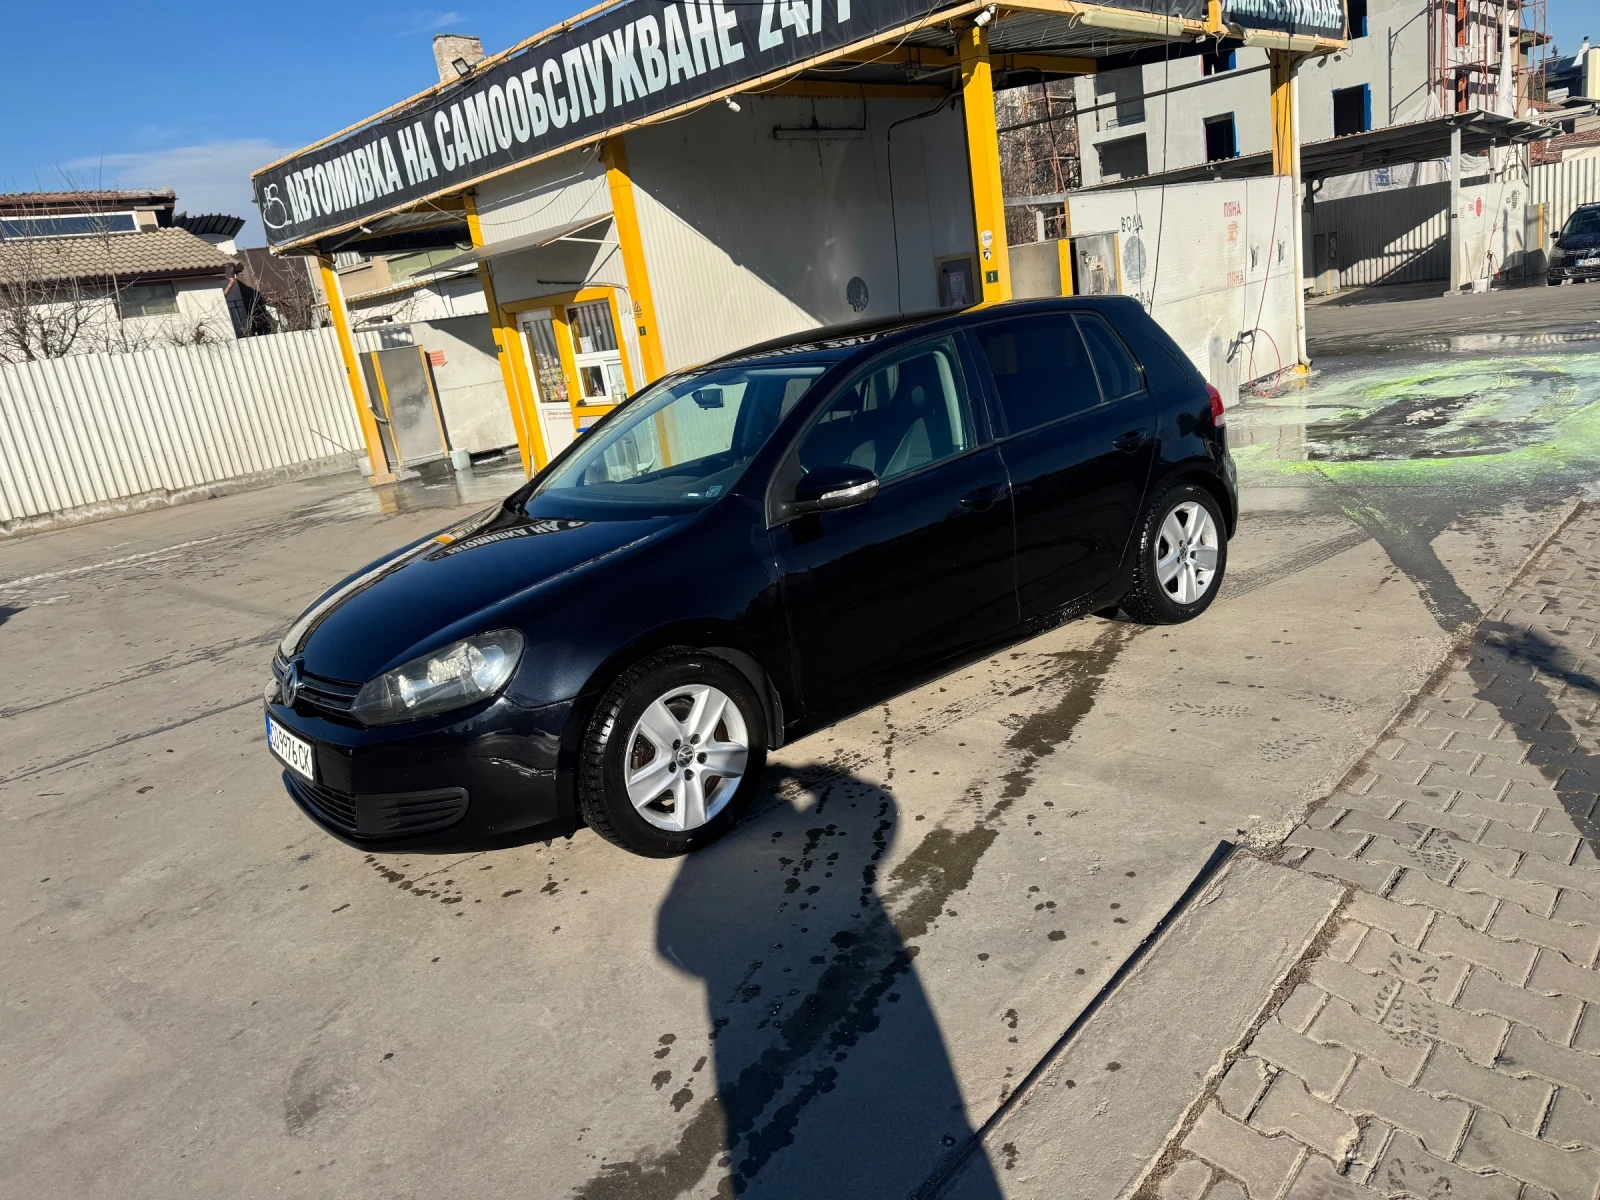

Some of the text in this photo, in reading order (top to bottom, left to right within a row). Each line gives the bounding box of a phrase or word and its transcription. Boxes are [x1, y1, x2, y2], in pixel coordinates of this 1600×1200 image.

[1221, 0, 1343, 29] АМООБСЛУЖВАНЕ
[284, 0, 851, 224] АВТОМИВКА НА САМООБСЛУЖВАНЕ 24/
[1223, 200, 1242, 218] ПЯНА
[1226, 269, 1245, 287] ПЯНА
